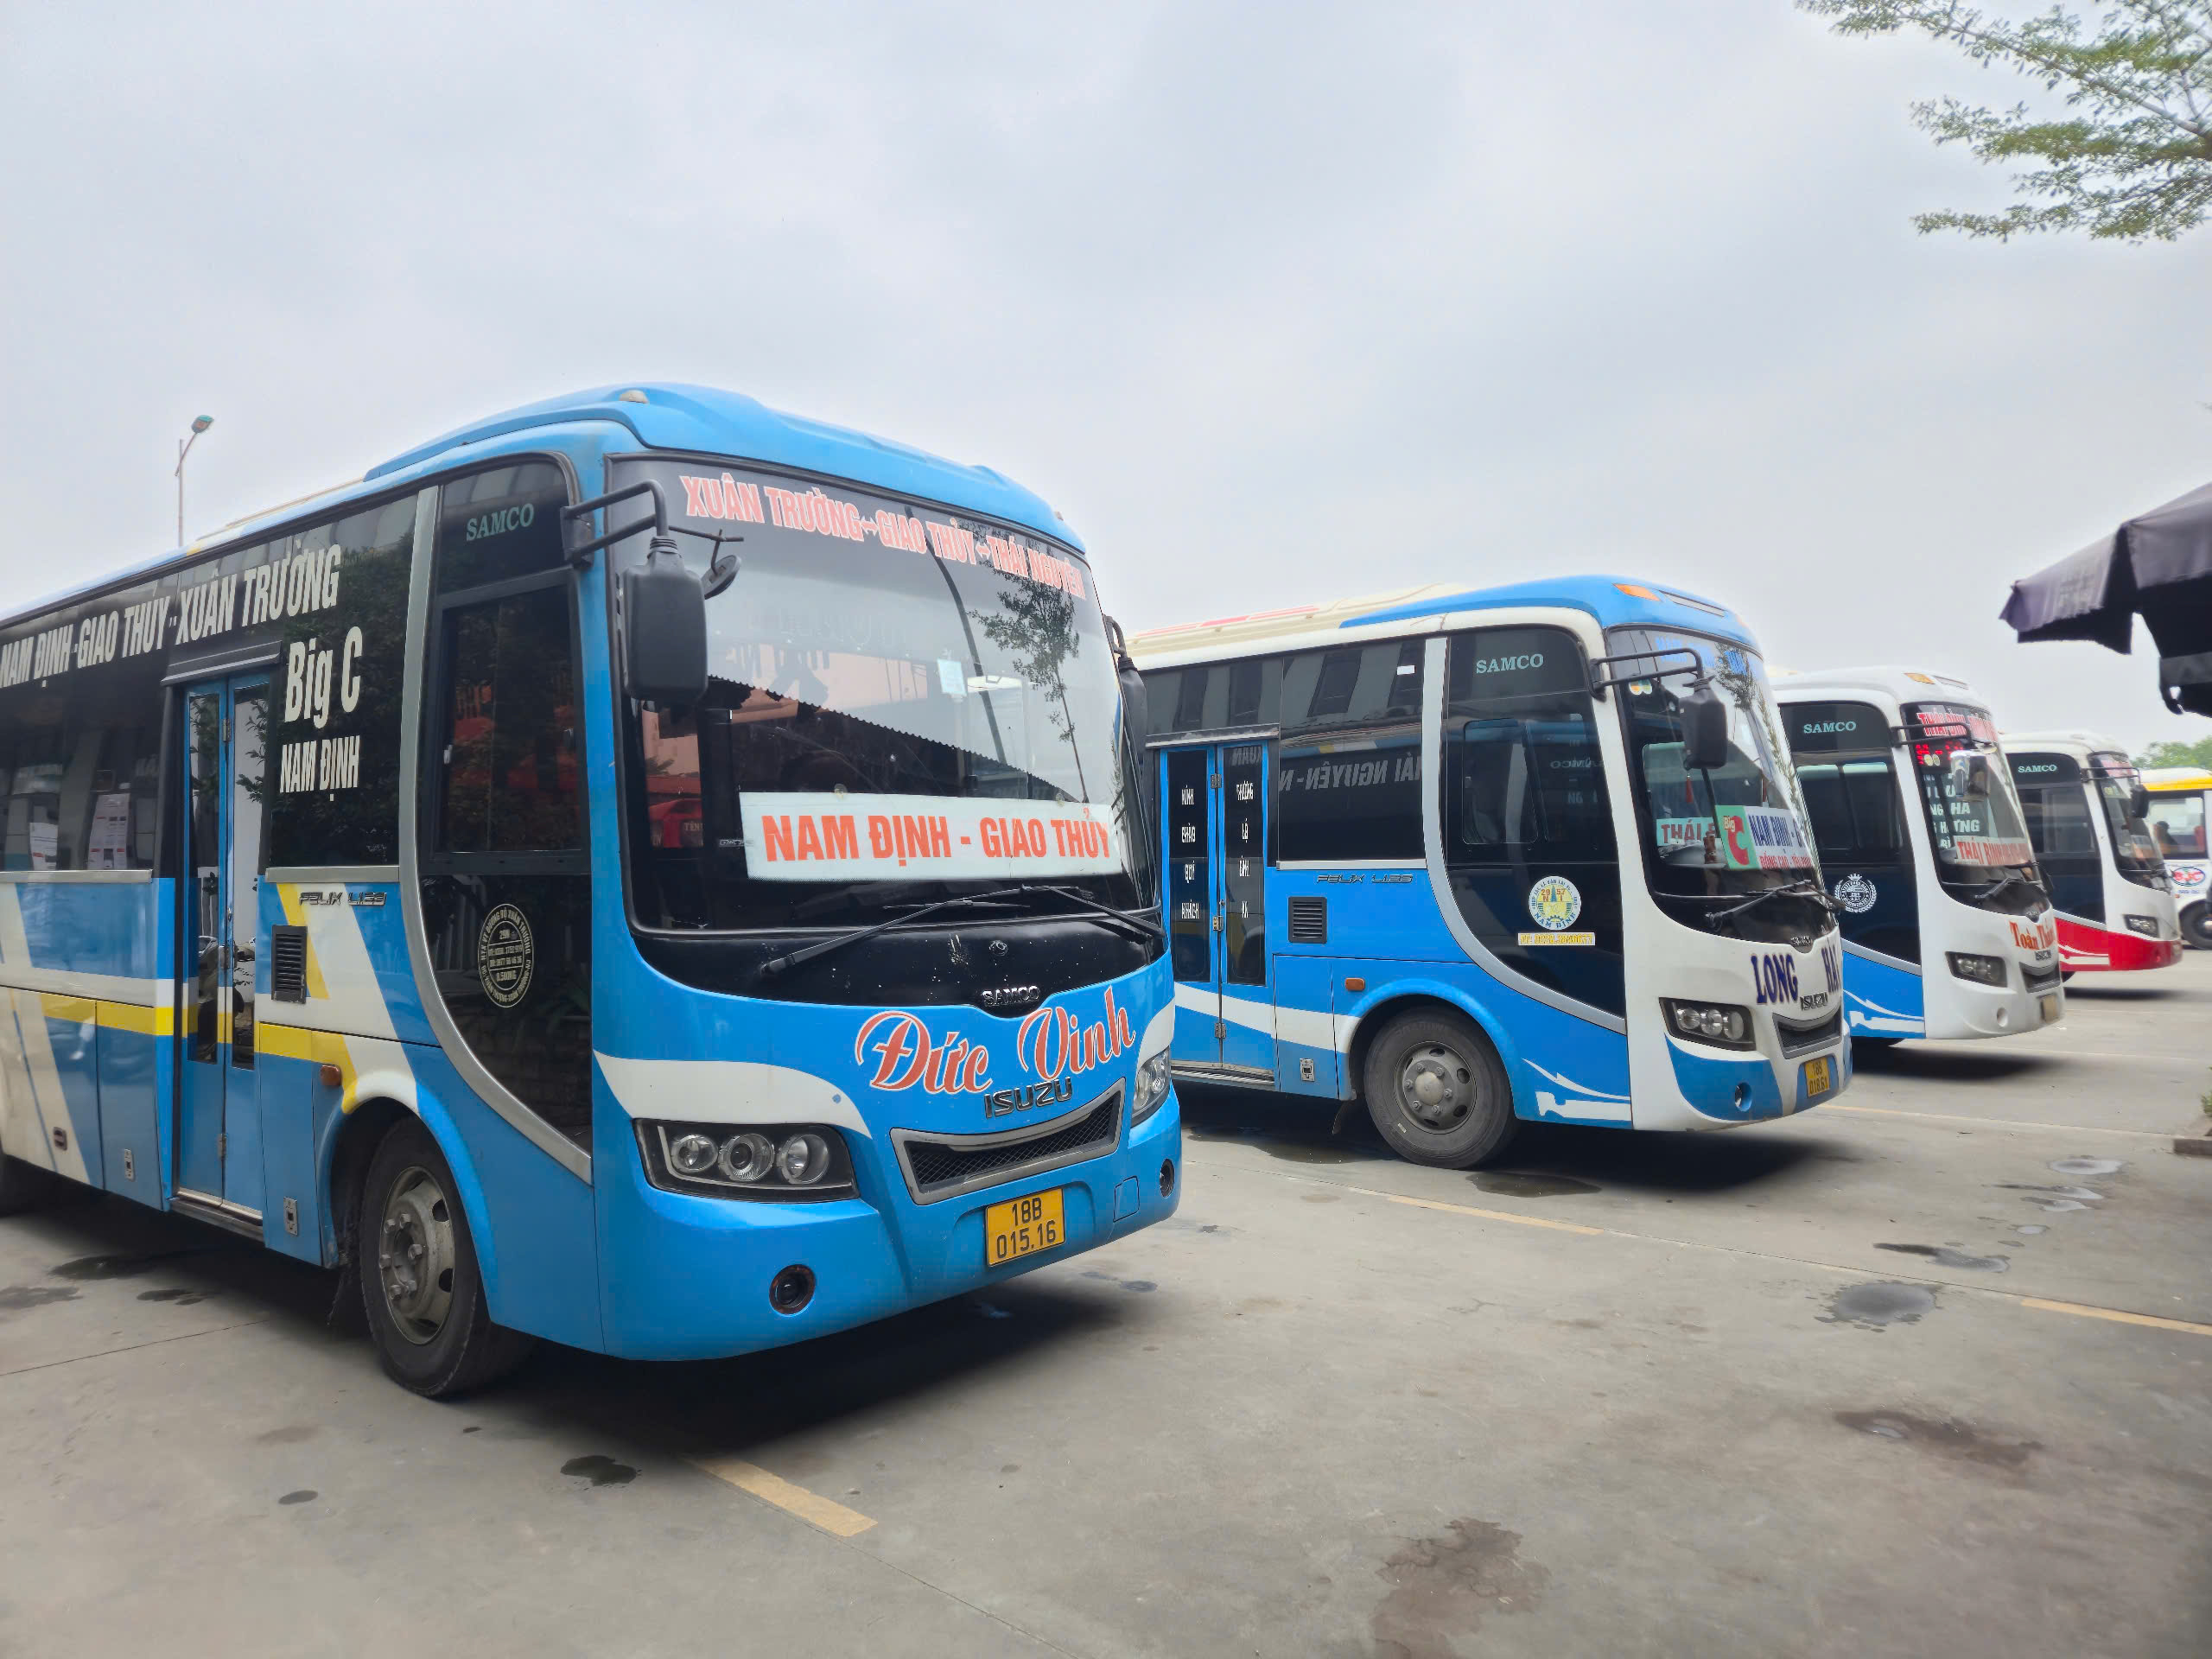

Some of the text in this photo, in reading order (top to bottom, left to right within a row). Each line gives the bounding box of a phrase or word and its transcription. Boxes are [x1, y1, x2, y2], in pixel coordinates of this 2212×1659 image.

[466, 503, 534, 542] SAMCO
[679, 473, 1086, 600] XUÂN TRƯỜNG GIAO THỦY THÁI NGUYÊN
[0, 637, 33, 688] NAM
[241, 539, 341, 627] TRƯỜNG
[284, 626, 362, 728] Big C
[1476, 653, 1544, 674] SAMCO
[1803, 721, 1857, 734] SAMCO
[280, 735, 360, 802] NAM ĐỊNH
[2018, 764, 2057, 773] SAMCO
[762, 807, 1110, 867] NAM ĐỊNH - GIAO THỦY
[1723, 815, 1736, 830] Big
[982, 986, 1039, 1007] SAMCO
[1751, 953, 1799, 1004] LONG
[855, 985, 1136, 1095] Đức Vinh
[983, 1077, 1073, 1119] ISUZU
[1012, 1197, 1042, 1224] 18B
[995, 1218, 1057, 1259] 015.16
